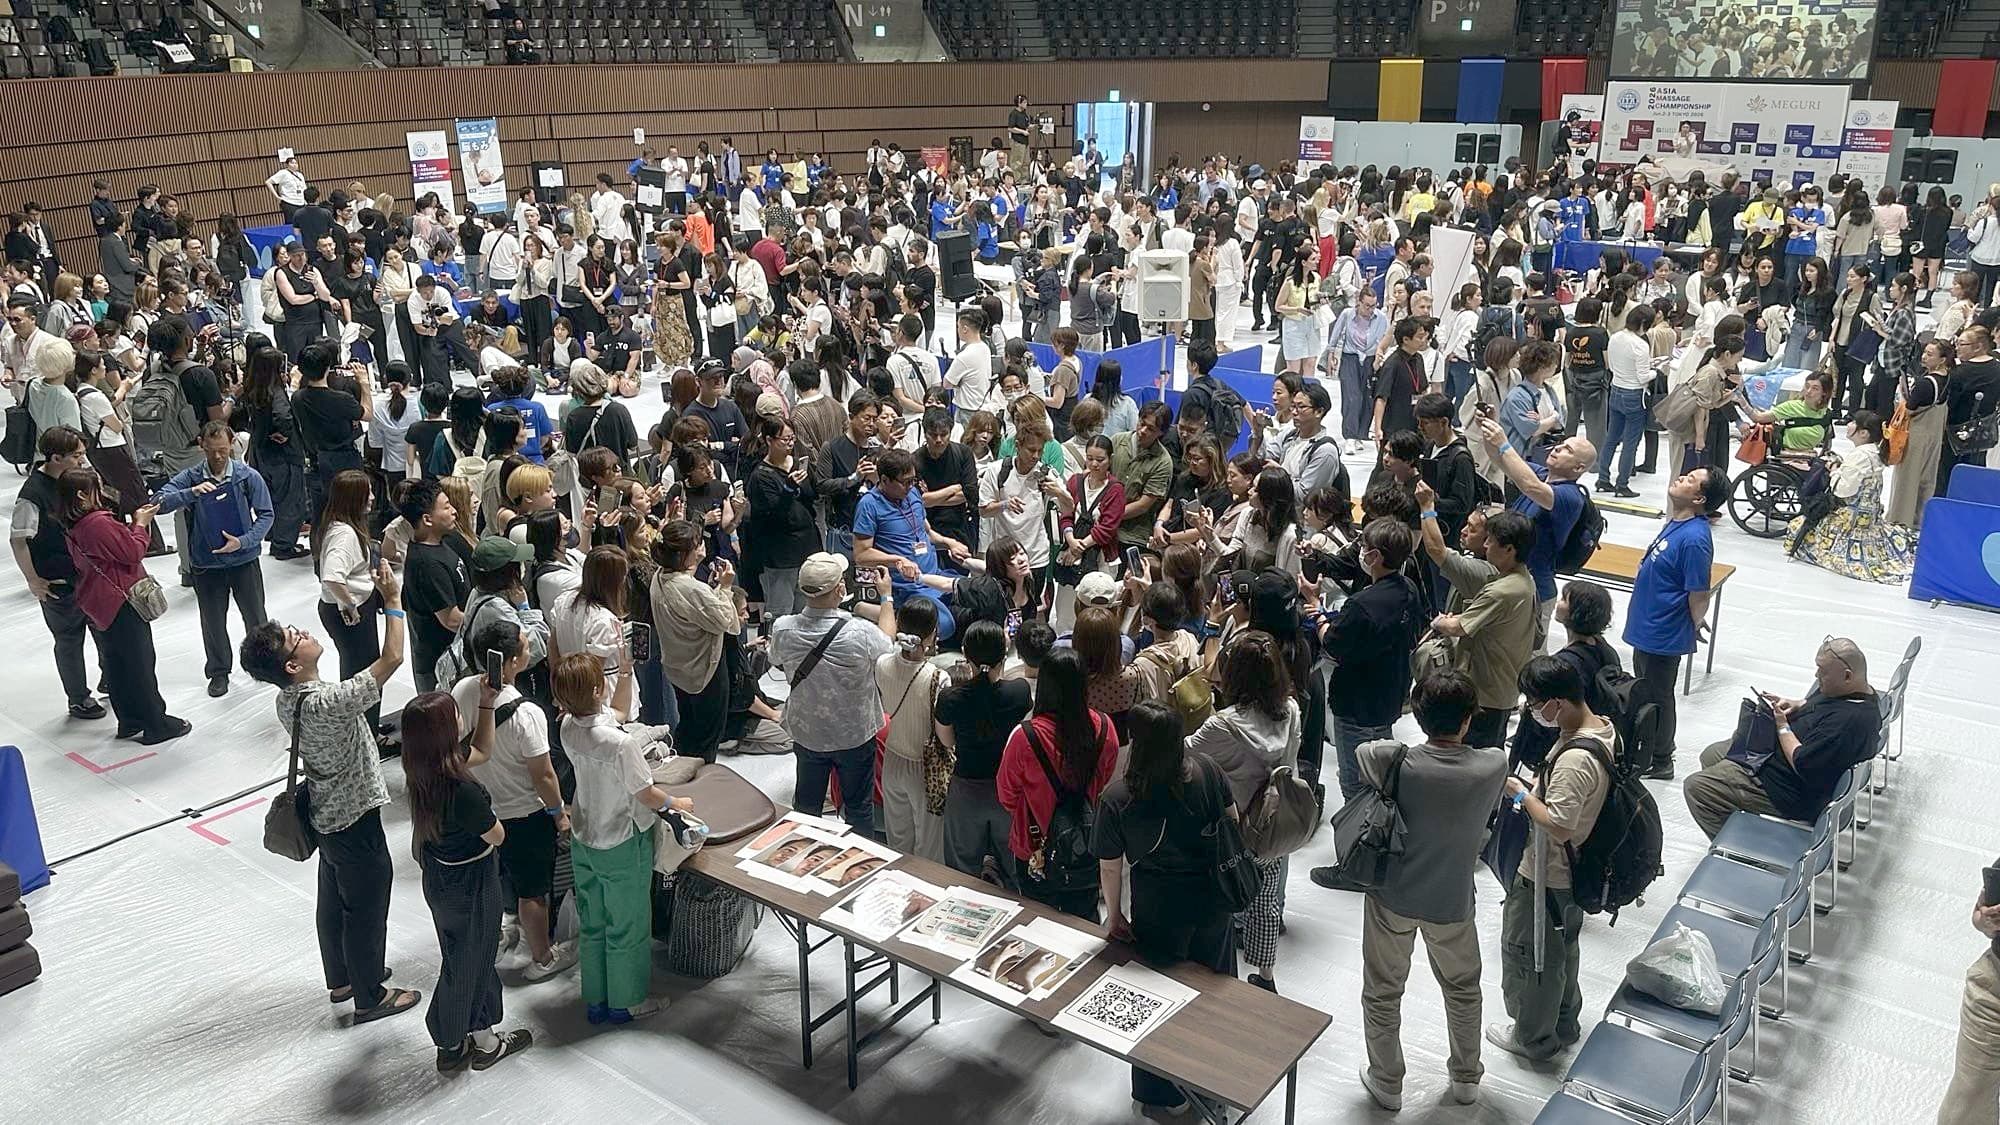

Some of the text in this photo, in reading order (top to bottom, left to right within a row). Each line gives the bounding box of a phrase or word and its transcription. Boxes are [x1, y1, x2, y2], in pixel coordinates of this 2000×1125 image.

[845, 4, 863, 27] N
[1431, 0, 1447, 22] P
[1771, 100, 1822, 110] MEGURI
[603, 342, 629, 350] TYO
